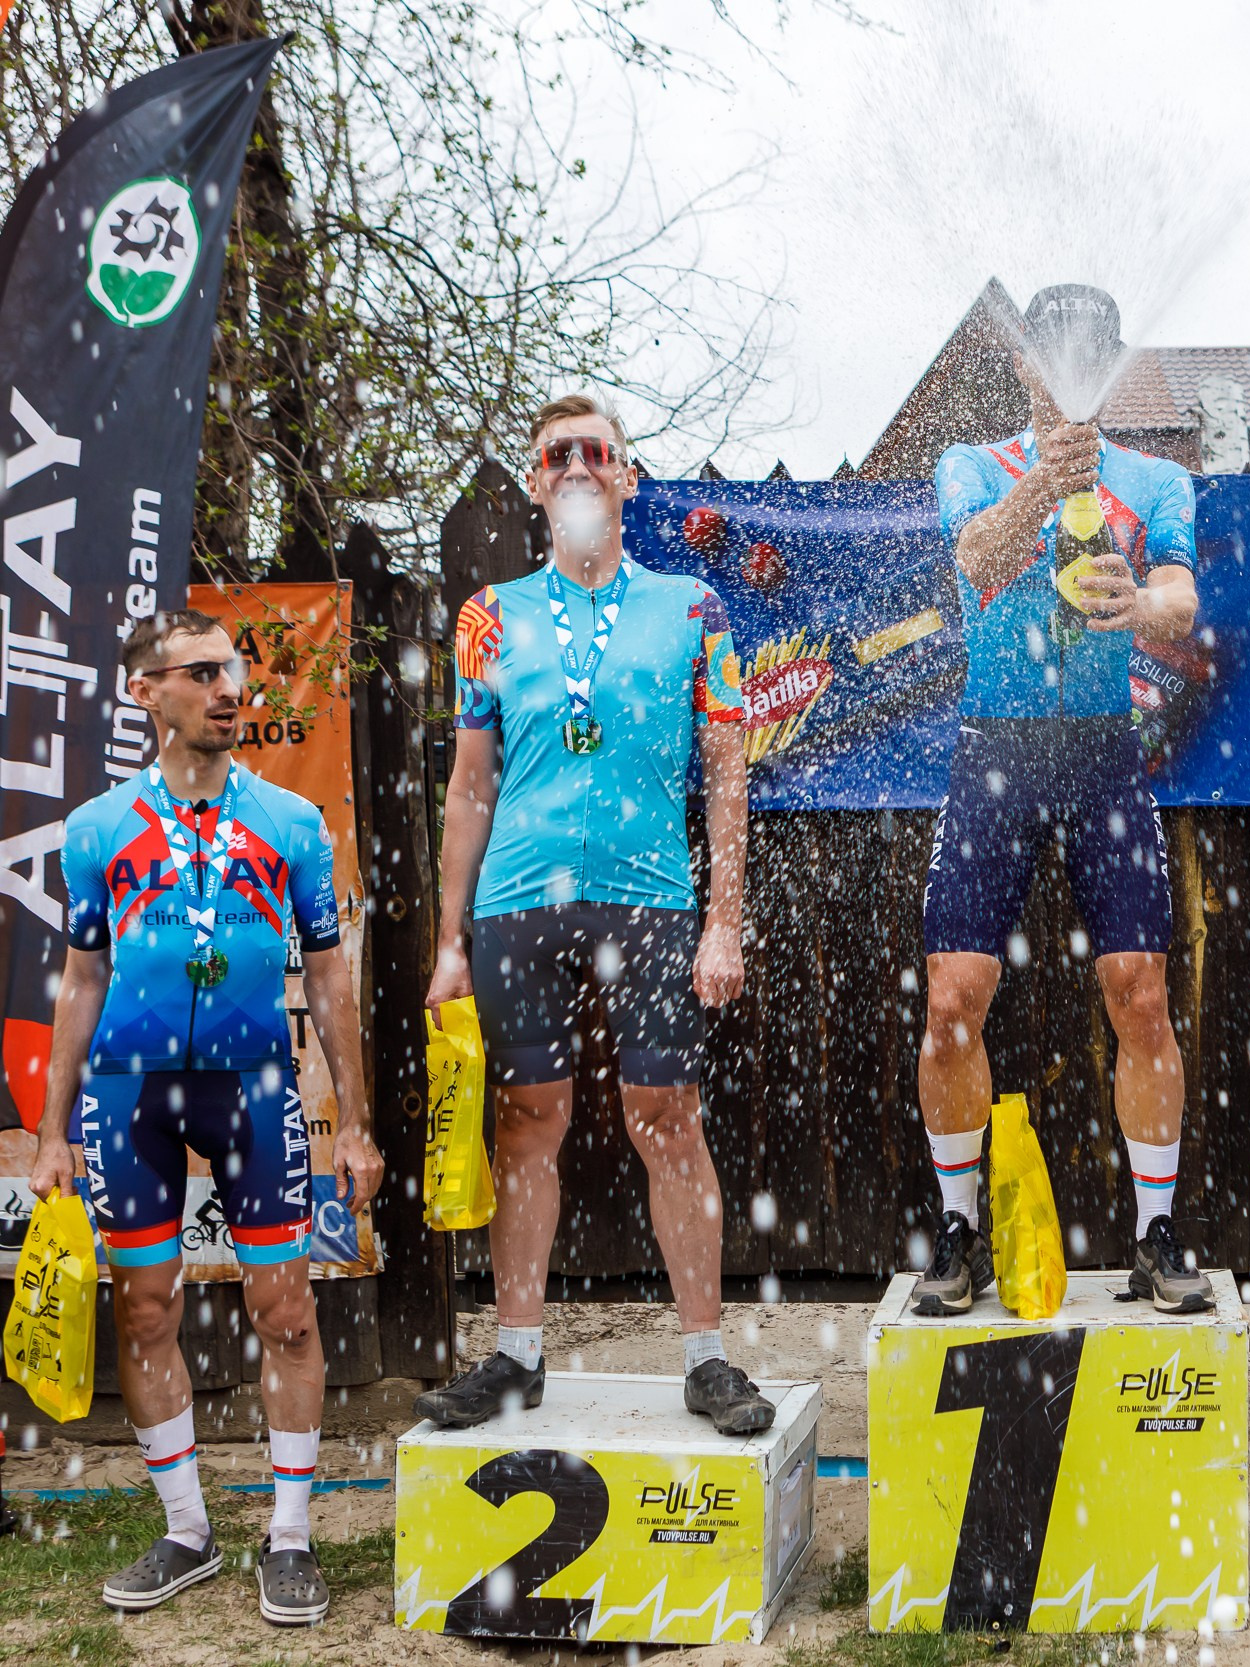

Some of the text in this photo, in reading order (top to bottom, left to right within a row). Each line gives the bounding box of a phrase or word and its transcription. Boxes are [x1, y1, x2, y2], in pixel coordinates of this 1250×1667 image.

[551, 575, 560, 594] ALTAY
[611, 578, 621, 599] ALTAY
[567, 649, 576, 670] ALTAY
[584, 650, 596, 671] ALTAY
[577, 737, 590, 754] 2
[158, 788, 171, 811] ALTAY
[222, 792, 233, 816] ALTAY
[111, 856, 285, 892] ALAY
[184, 872, 198, 897] ALTAY
[205, 874, 216, 899] ALTAY
[77, 1093, 115, 1219] ALTAY
[283, 1086, 310, 1207] ALTAY
[1120, 1367, 1216, 1401] PULSE
[1117, 1405, 1130, 1413] СЕТЬ
[1131, 1405, 1163, 1413] МАГАЗИНО
[1190, 1404, 1221, 1412] АКТИВНЫХ
[1144, 1420, 1197, 1430] TVOYPULSE.RU
[935, 1327, 1086, 1632] 1
[640, 1482, 736, 1515] PULSE
[651, 1518, 684, 1526] МАГАЗИНОВ
[709, 1519, 739, 1527] АКТИВНЫХ
[442, 1450, 610, 1638] 2
[657, 1531, 710, 1542] TVOYPULSE.RU
